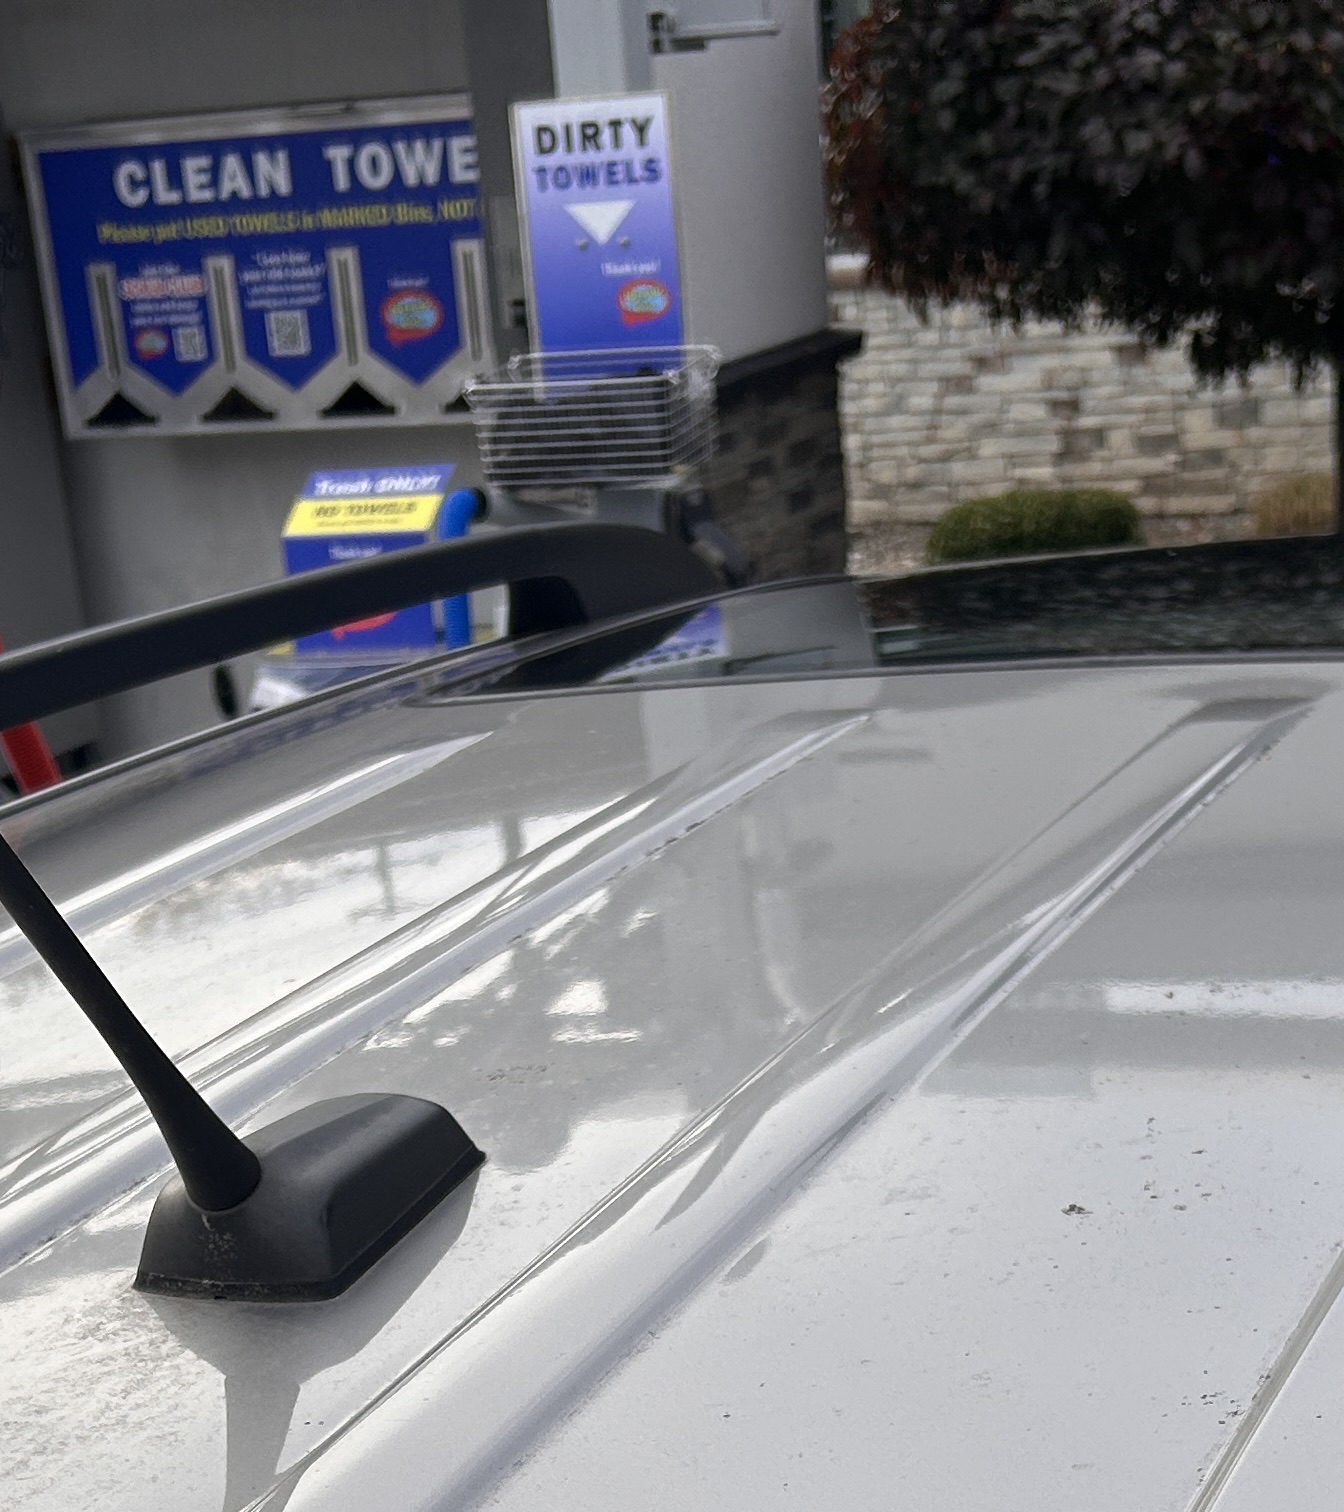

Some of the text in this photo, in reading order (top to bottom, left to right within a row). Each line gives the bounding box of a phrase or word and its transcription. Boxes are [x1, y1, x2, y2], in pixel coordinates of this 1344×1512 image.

[535, 116, 653, 154] DIRTY
[112, 134, 481, 208] CLEAN TOWE
[533, 157, 662, 193] TOWELS
